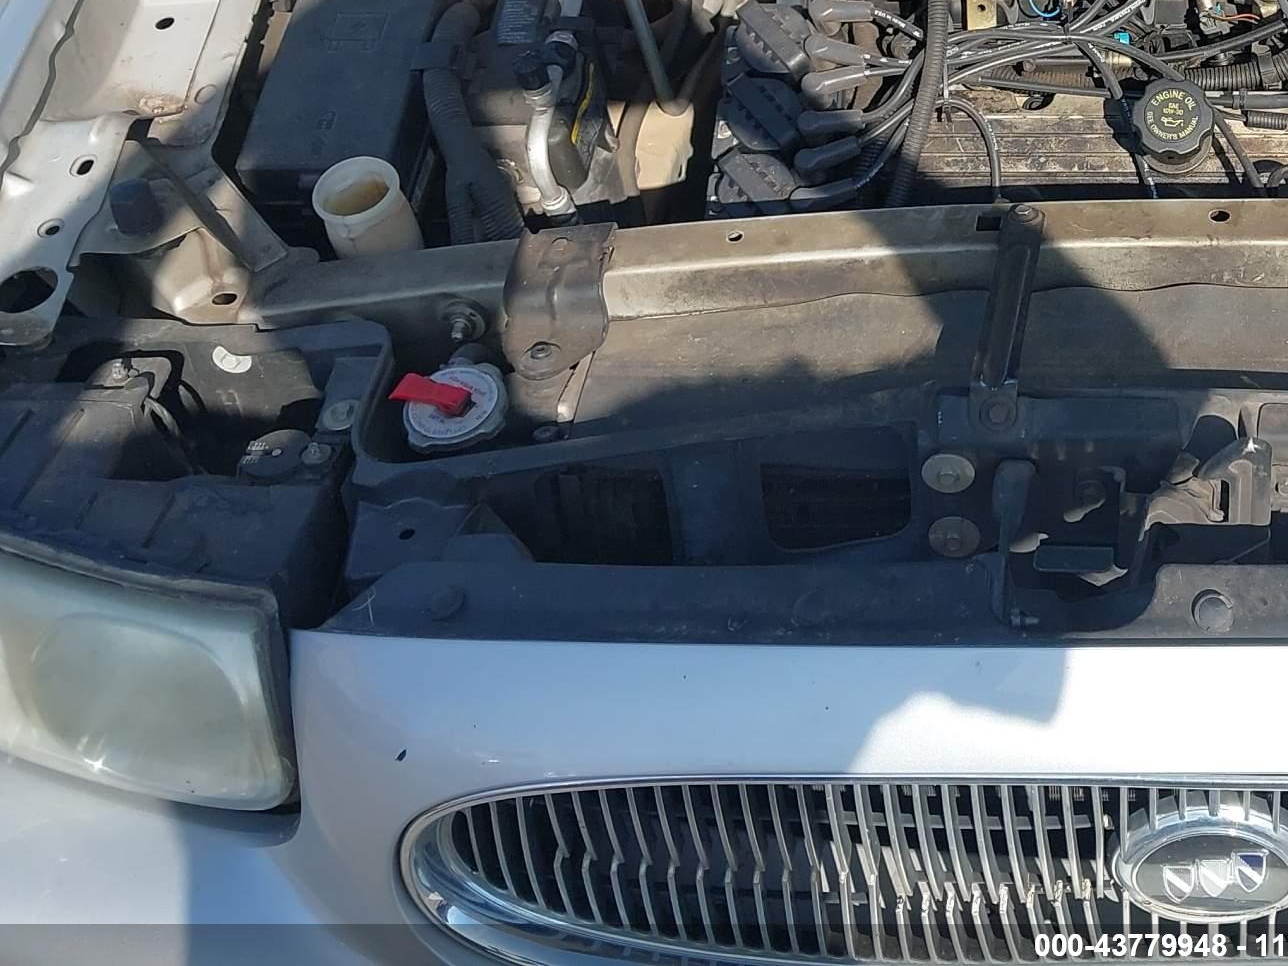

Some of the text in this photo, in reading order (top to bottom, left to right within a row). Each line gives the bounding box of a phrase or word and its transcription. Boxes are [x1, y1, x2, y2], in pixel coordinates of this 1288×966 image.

[1151, 90, 1197, 111] ENGINE OIL
[1150, 124, 1178, 140] OWNER'S
[1178, 116, 1198, 139] MANUAL
